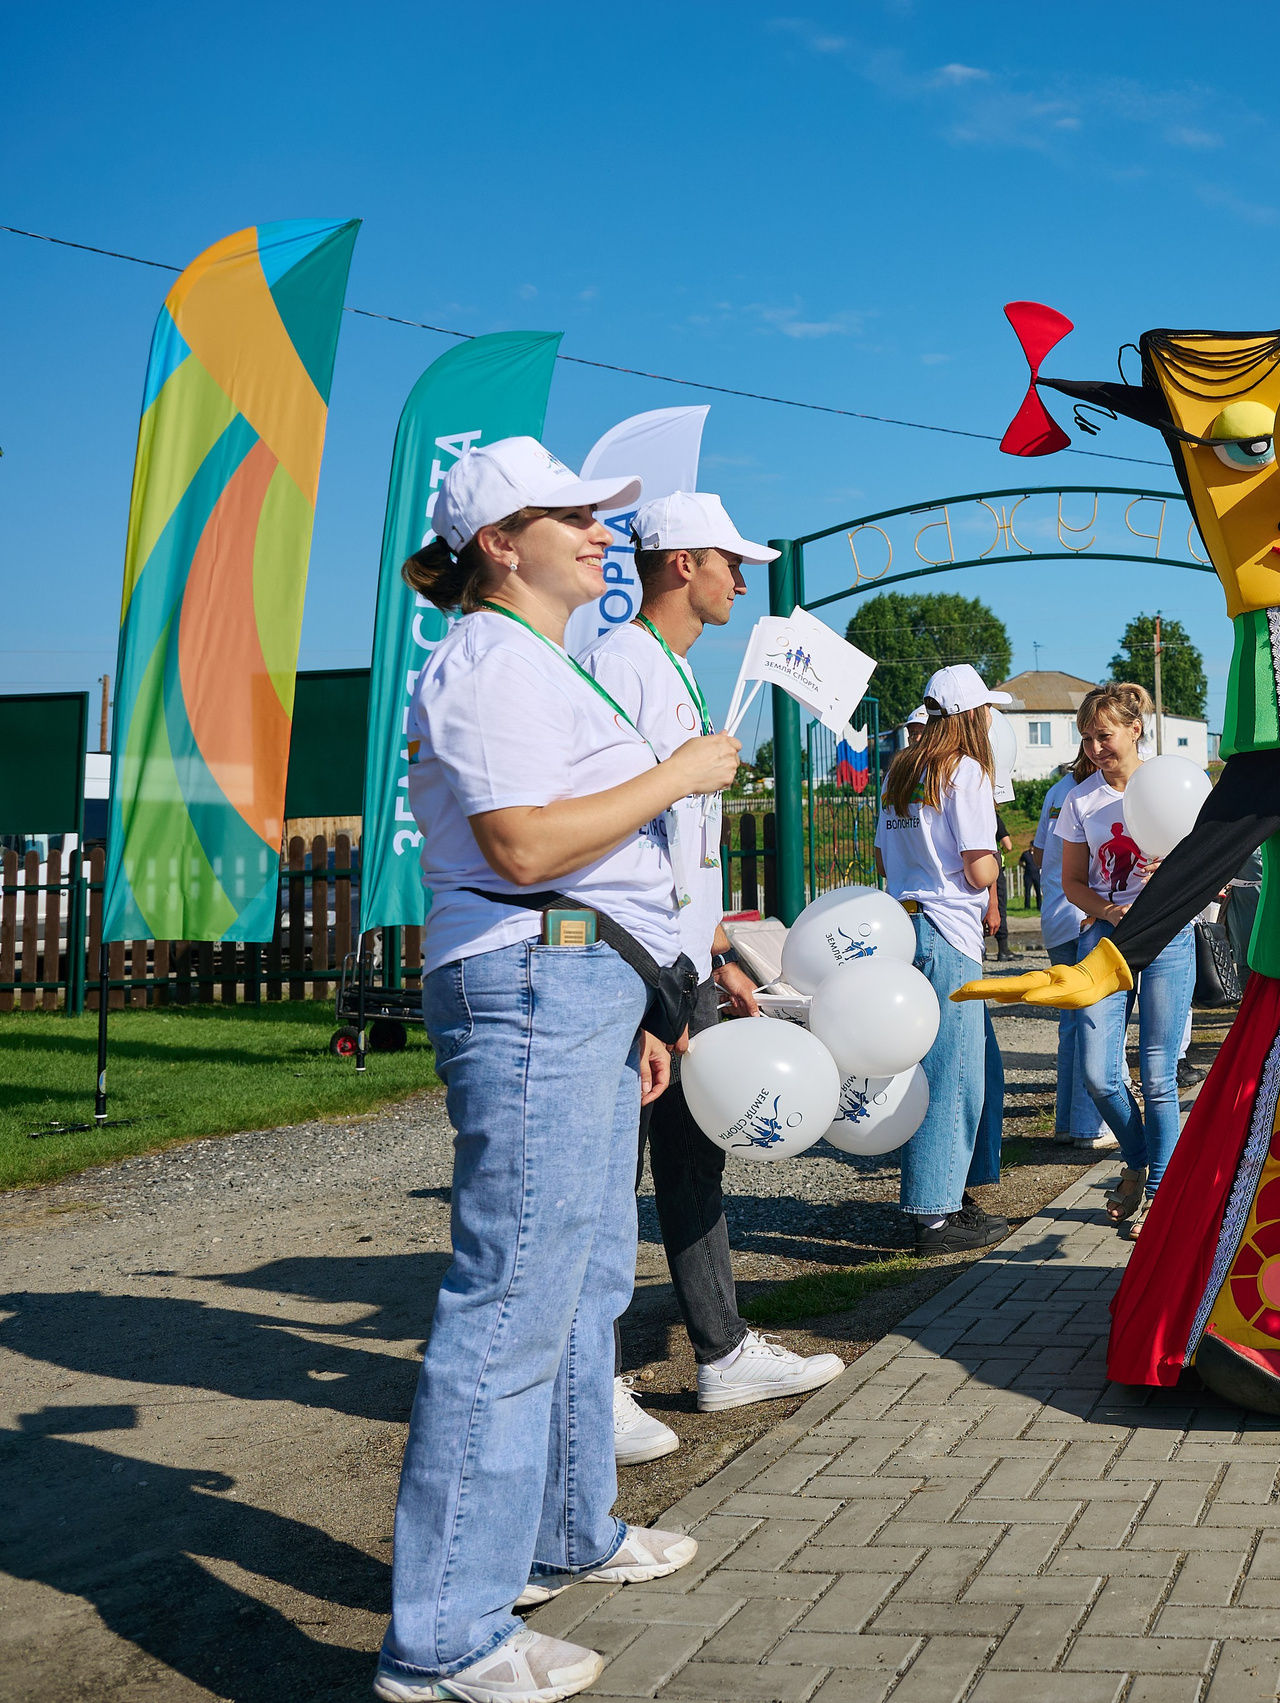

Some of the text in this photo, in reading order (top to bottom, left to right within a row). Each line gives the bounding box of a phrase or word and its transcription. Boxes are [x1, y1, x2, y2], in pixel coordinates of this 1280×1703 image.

[598, 510, 638, 637] ОРТА
[764, 660, 792, 673] ЗЕМЛЯ
[793, 671, 819, 692] СПОРТА
[886, 816, 920, 830] ВОЛОНТЁР
[825, 932, 843, 961] ЗЕМЛЯ
[718, 1088, 770, 1141] ЗЕМЛЯ СПОРТА
